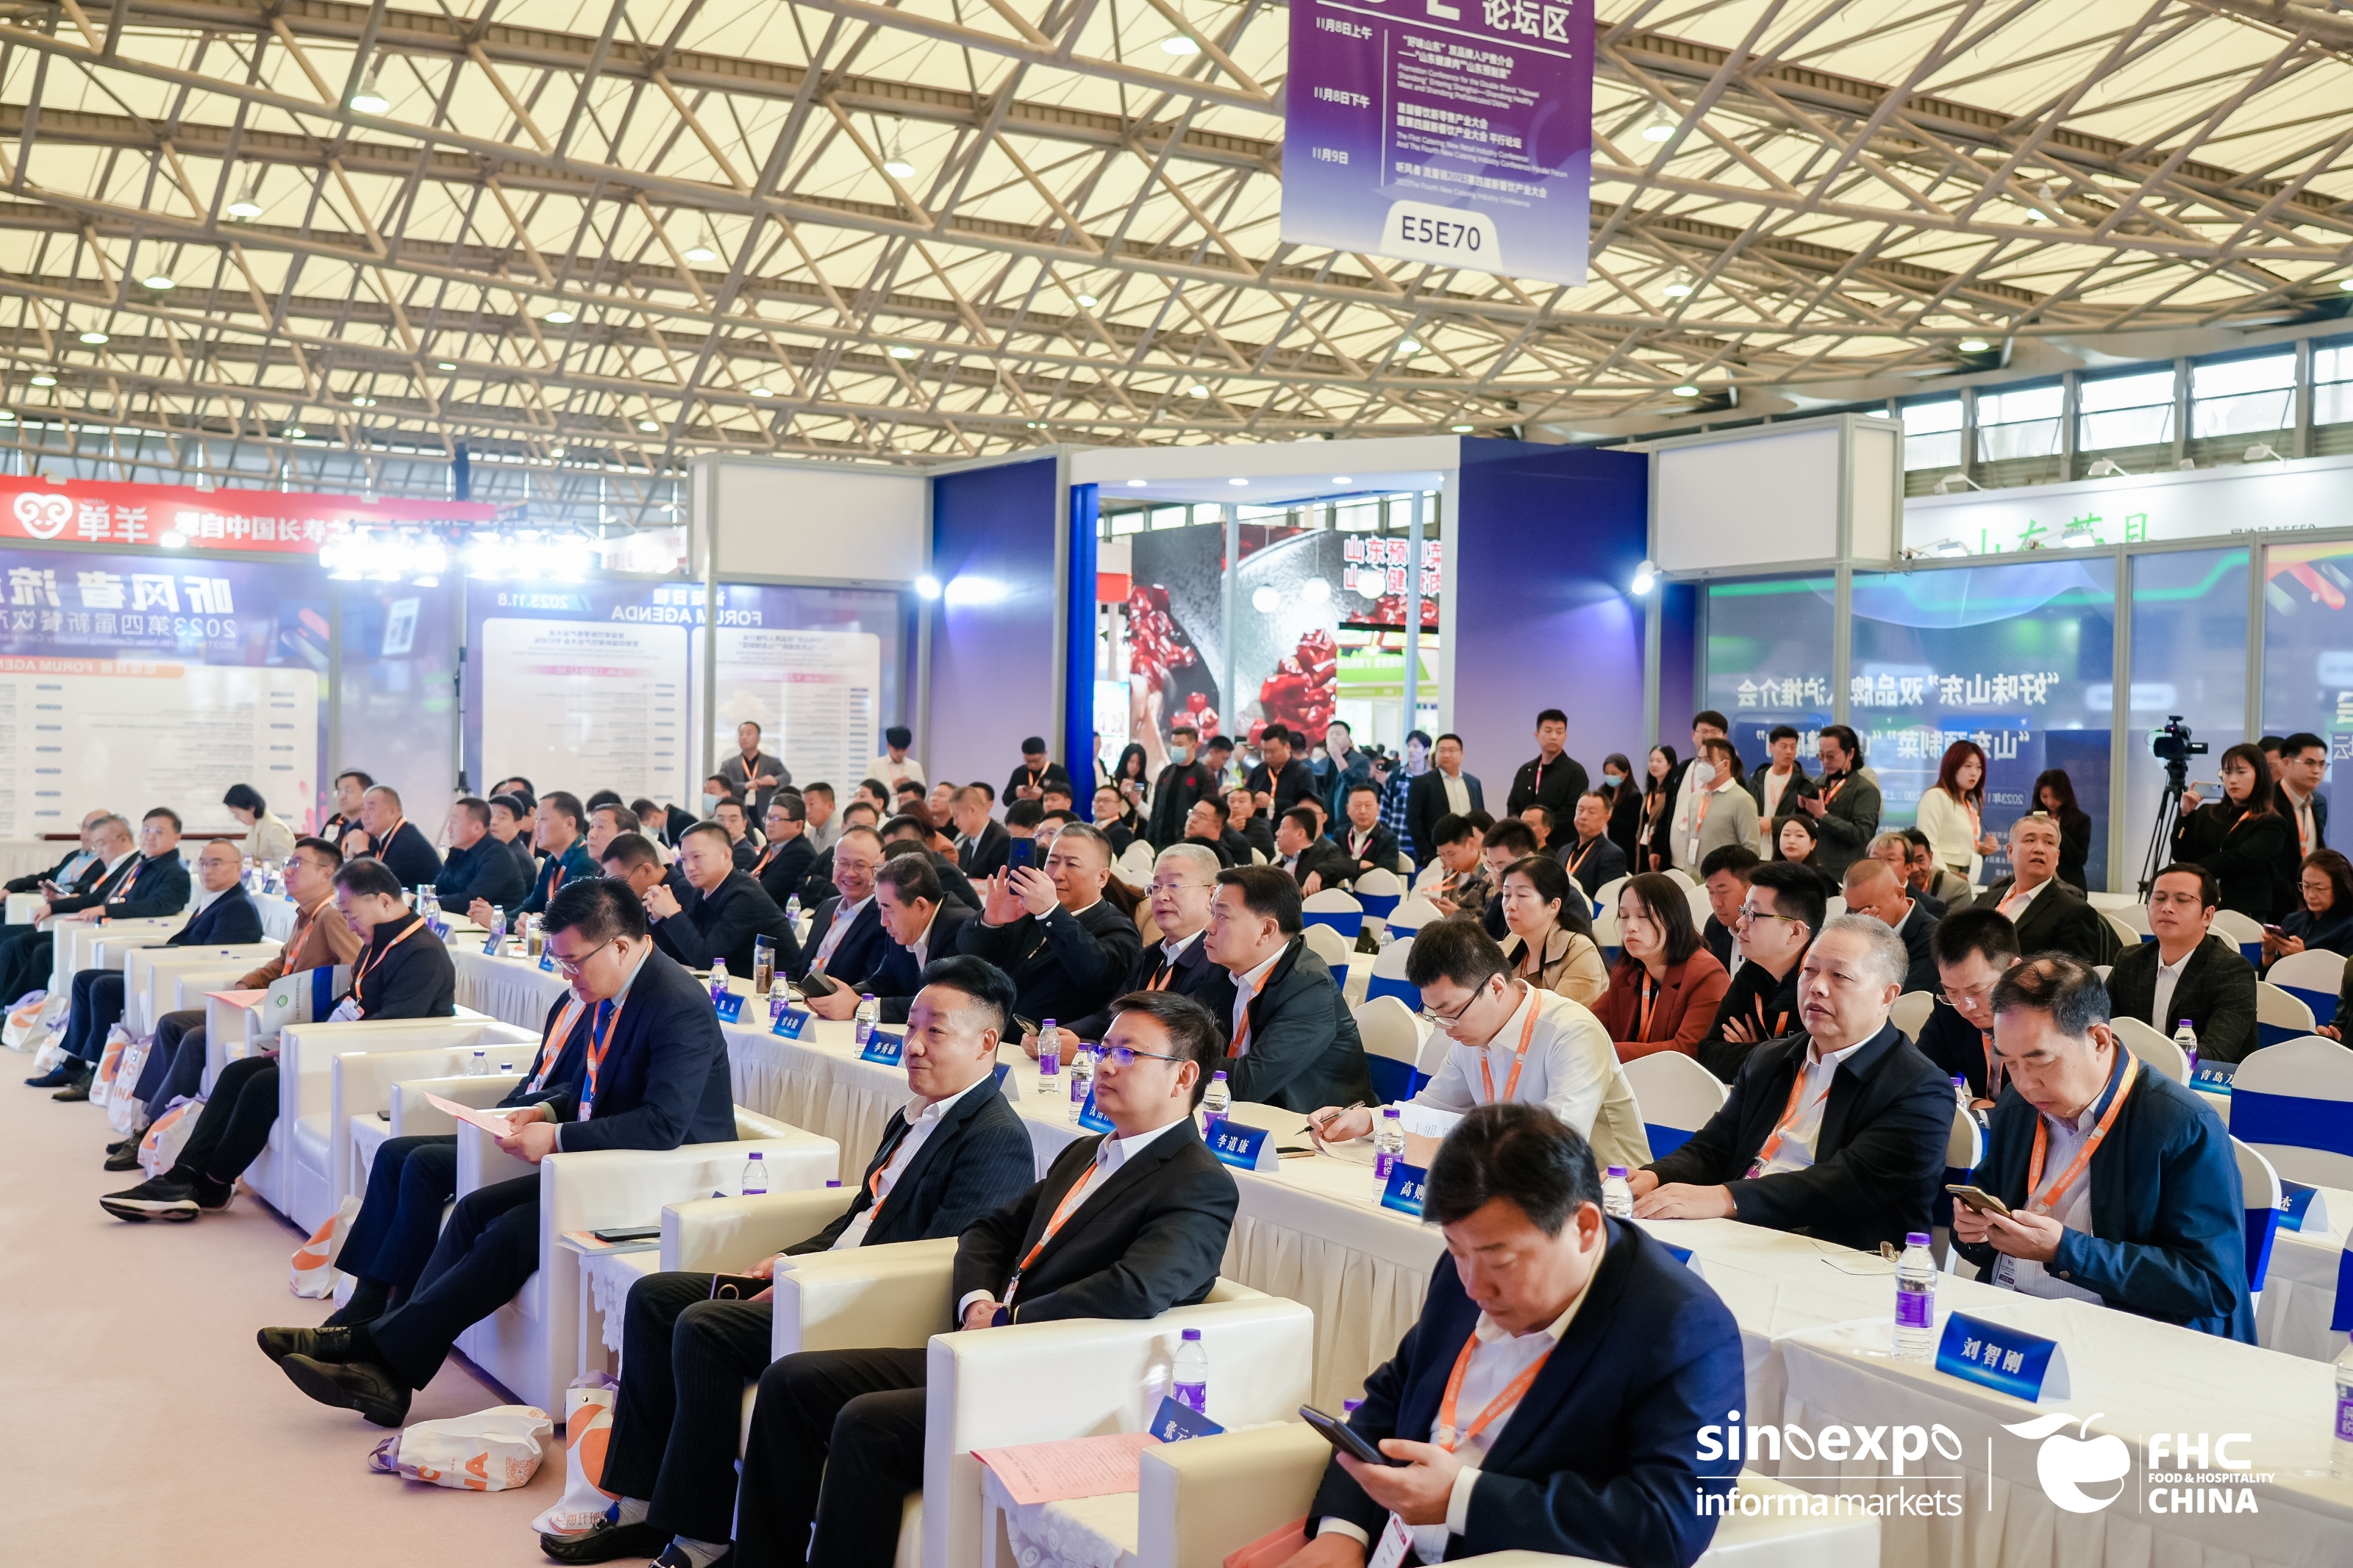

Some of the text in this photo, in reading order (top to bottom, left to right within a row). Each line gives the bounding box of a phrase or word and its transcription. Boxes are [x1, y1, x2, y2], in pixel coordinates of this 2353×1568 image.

[1316, 17, 1373, 40] 11月8日上午
[1482, 0, 1569, 43] 论坛区
[1314, 87, 1371, 108] 11月8日下午
[1312, 147, 1349, 165] 11月9日
[1402, 215, 1481, 251] E5E70
[1217, 1133, 1249, 1153] 李道康
[2279, 1195, 2293, 1212] 杰
[1961, 1336, 2024, 1375] 刘智刚
[1163, 1420, 1199, 1441] 张云
